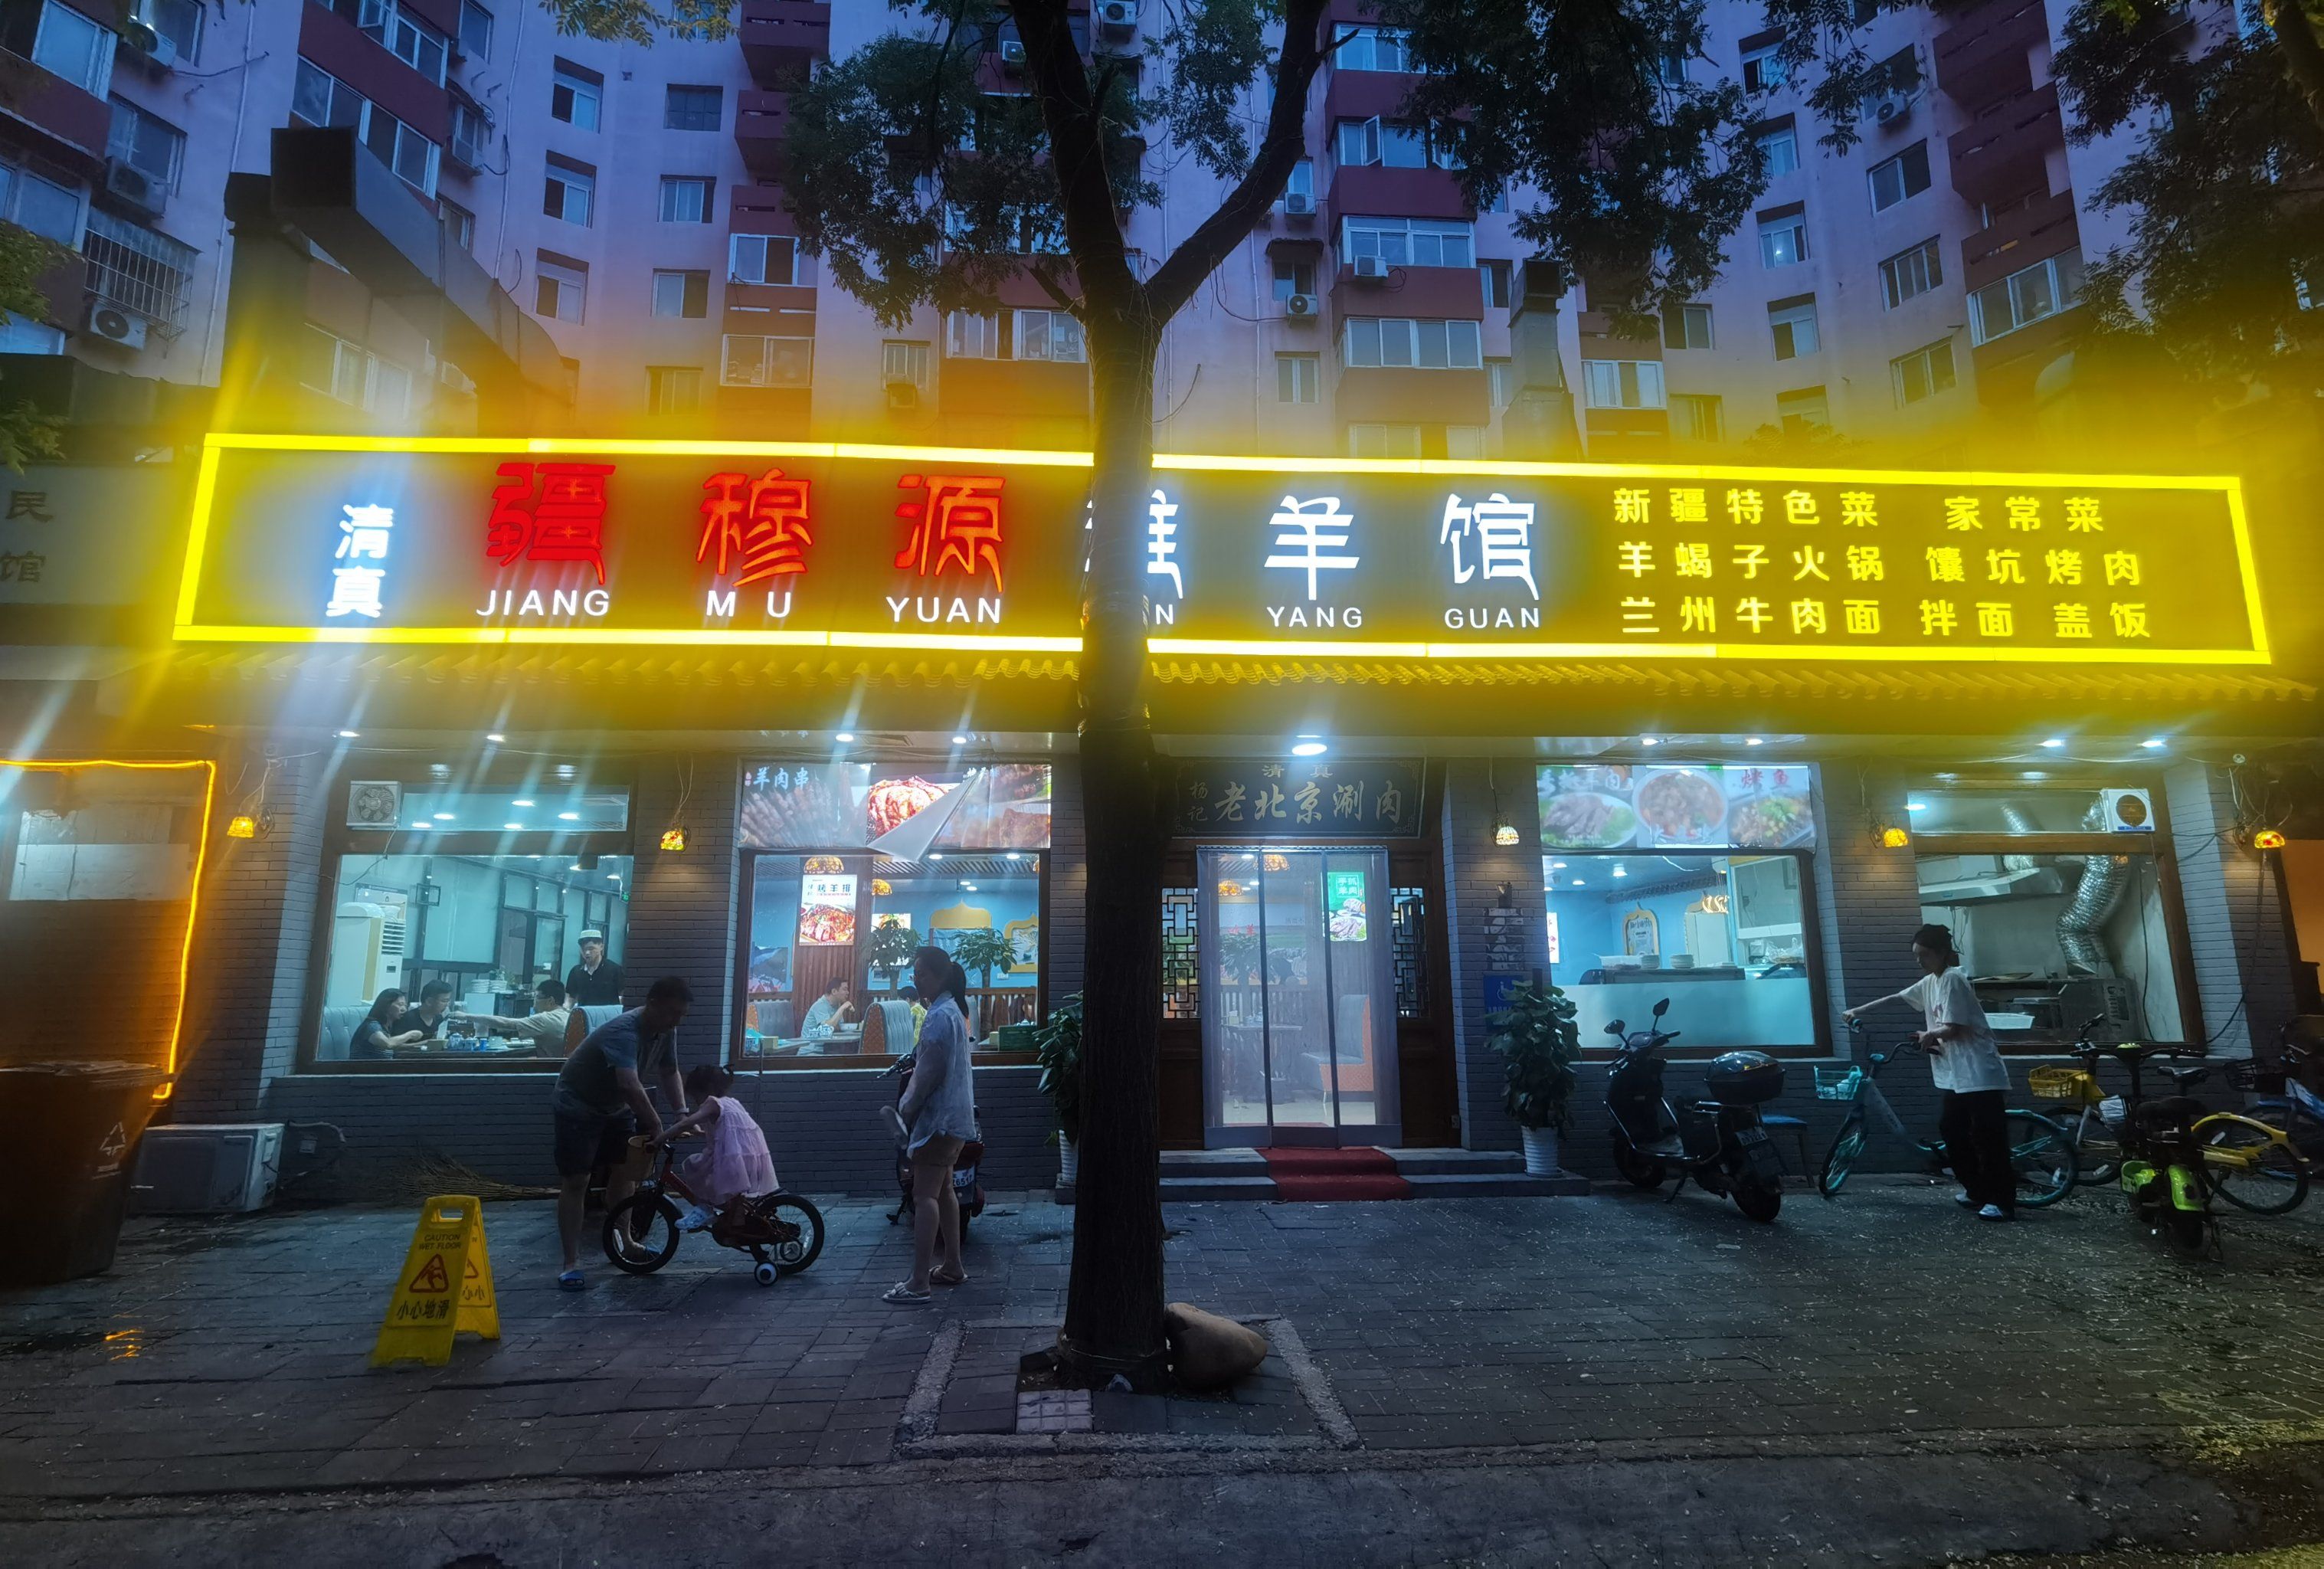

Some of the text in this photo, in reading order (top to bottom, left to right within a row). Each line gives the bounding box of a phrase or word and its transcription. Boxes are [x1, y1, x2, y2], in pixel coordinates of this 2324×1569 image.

[5, 490, 54, 522] 民
[1614, 487, 2104, 532] 新疆特色菜 家常菜
[326, 503, 394, 618] 清真
[1618, 541, 2142, 586] 羊蝎子火锅 馕坑烤肉
[476, 590, 610, 617] JIANG
[886, 598, 1001, 624] YUAN
[1267, 606, 1363, 628] YANG
[1445, 608, 1540, 629] GUAN
[1620, 596, 2152, 639] 兰州牛肉面 拌面 盖饭
[753, 766, 810, 791] 羊肉串
[1262, 765, 1333, 778] 清真
[1188, 781, 1209, 822] 杨记
[1214, 780, 1403, 825] 老北京涮肉
[424, 1233, 461, 1242] CAUTION
[397, 1299, 450, 1320] 小心地滑
